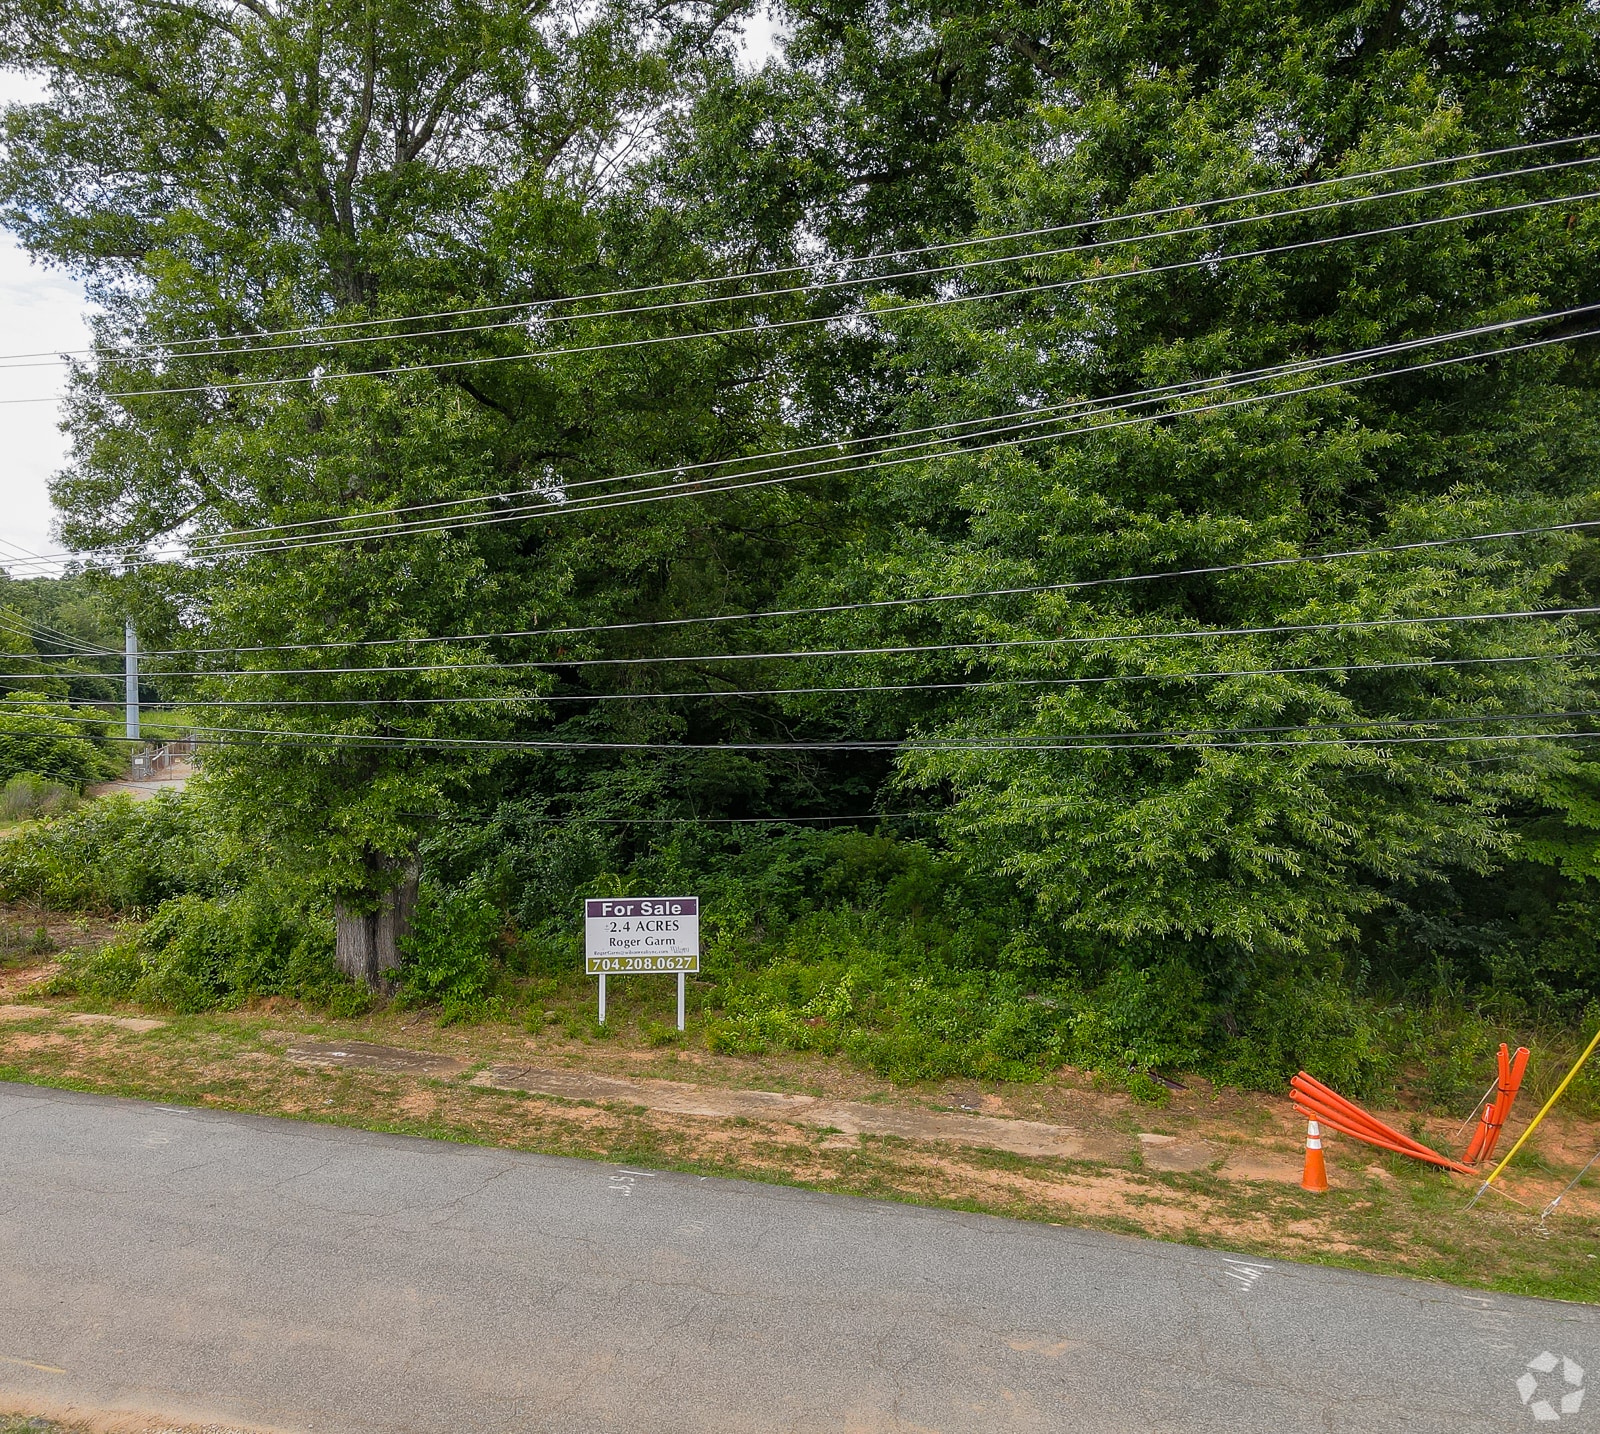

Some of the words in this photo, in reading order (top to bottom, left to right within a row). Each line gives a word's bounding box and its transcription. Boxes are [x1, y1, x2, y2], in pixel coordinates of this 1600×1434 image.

[602, 902, 634, 916] For
[640, 901, 682, 915] Sale
[635, 919, 680, 932] ACRES
[609, 937, 641, 948] Roger
[645, 936, 676, 946] Garm
[592, 957, 692, 971] 704.208.0627
